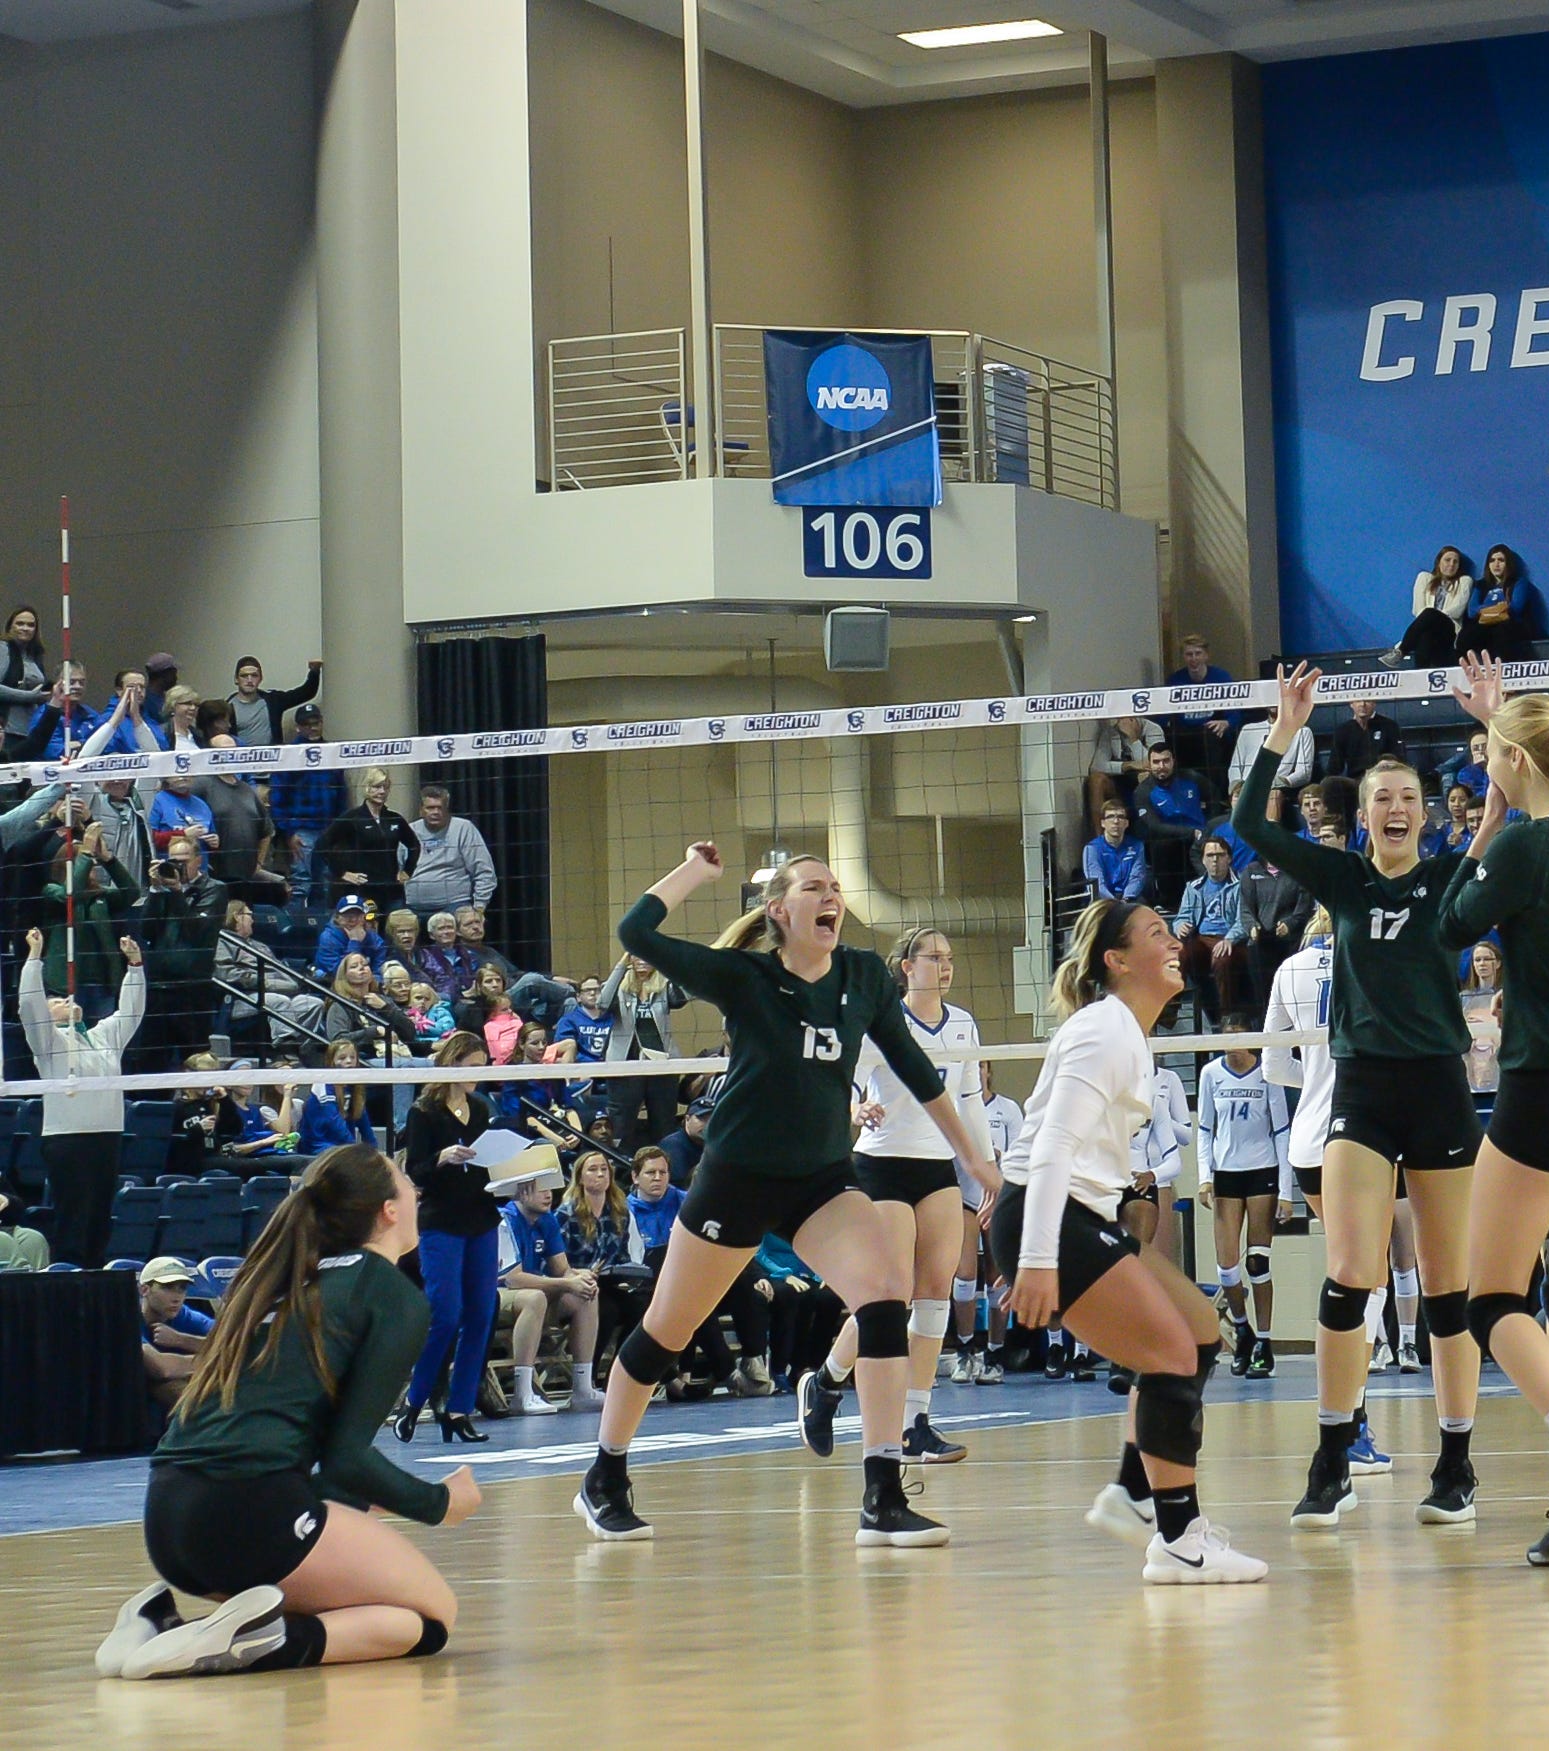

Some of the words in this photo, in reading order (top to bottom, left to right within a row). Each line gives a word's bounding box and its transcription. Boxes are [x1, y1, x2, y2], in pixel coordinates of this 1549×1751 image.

[816, 386, 889, 411] NCAA
[810, 512, 924, 571] 106
[1317, 672, 1400, 693] CREIGHTON
[1170, 683, 1251, 702] CREIGHTON
[1026, 694, 1105, 713] CREIGHTON
[744, 713, 821, 731] CREIGHTON
[883, 704, 962, 723] CREIGHTON
[472, 730, 547, 749] CREIGHTON
[606, 722, 681, 739] CREIGHTON
[208, 747, 281, 765] CREIGHTON
[339, 740, 412, 758] CREIGHTON
[77, 754, 149, 772] CREIGHTON
[1369, 907, 1411, 940] 17
[801, 1021, 843, 1061] 13
[1229, 1102, 1250, 1121] 14
